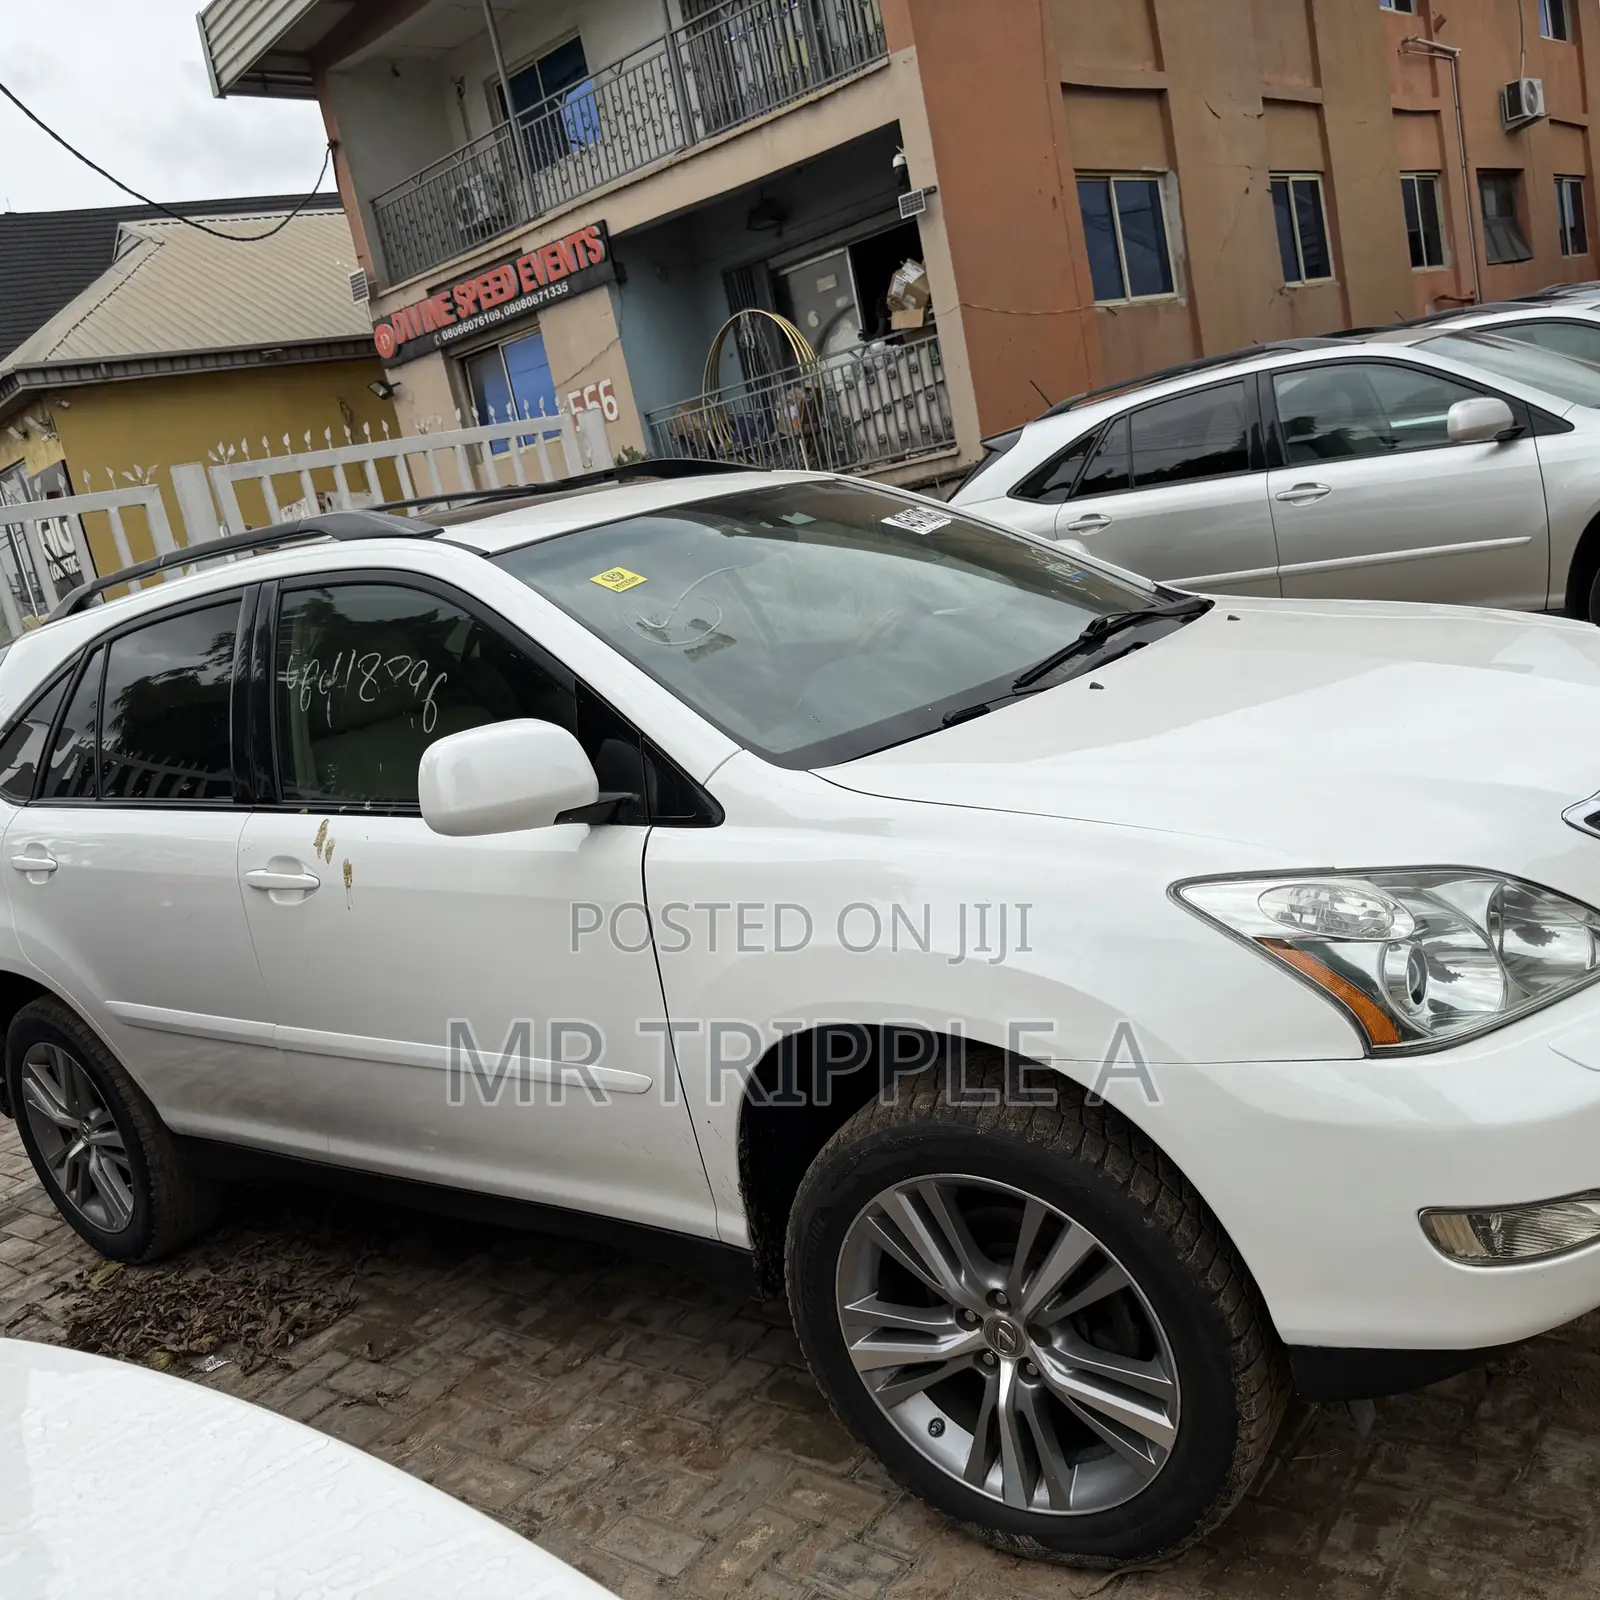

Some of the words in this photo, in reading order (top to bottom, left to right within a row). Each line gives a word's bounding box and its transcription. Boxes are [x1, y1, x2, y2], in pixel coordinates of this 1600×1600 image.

[391, 290, 455, 345] DIVINE
[453, 264, 519, 319] SPEED
[516, 225, 604, 293] EVENTS
